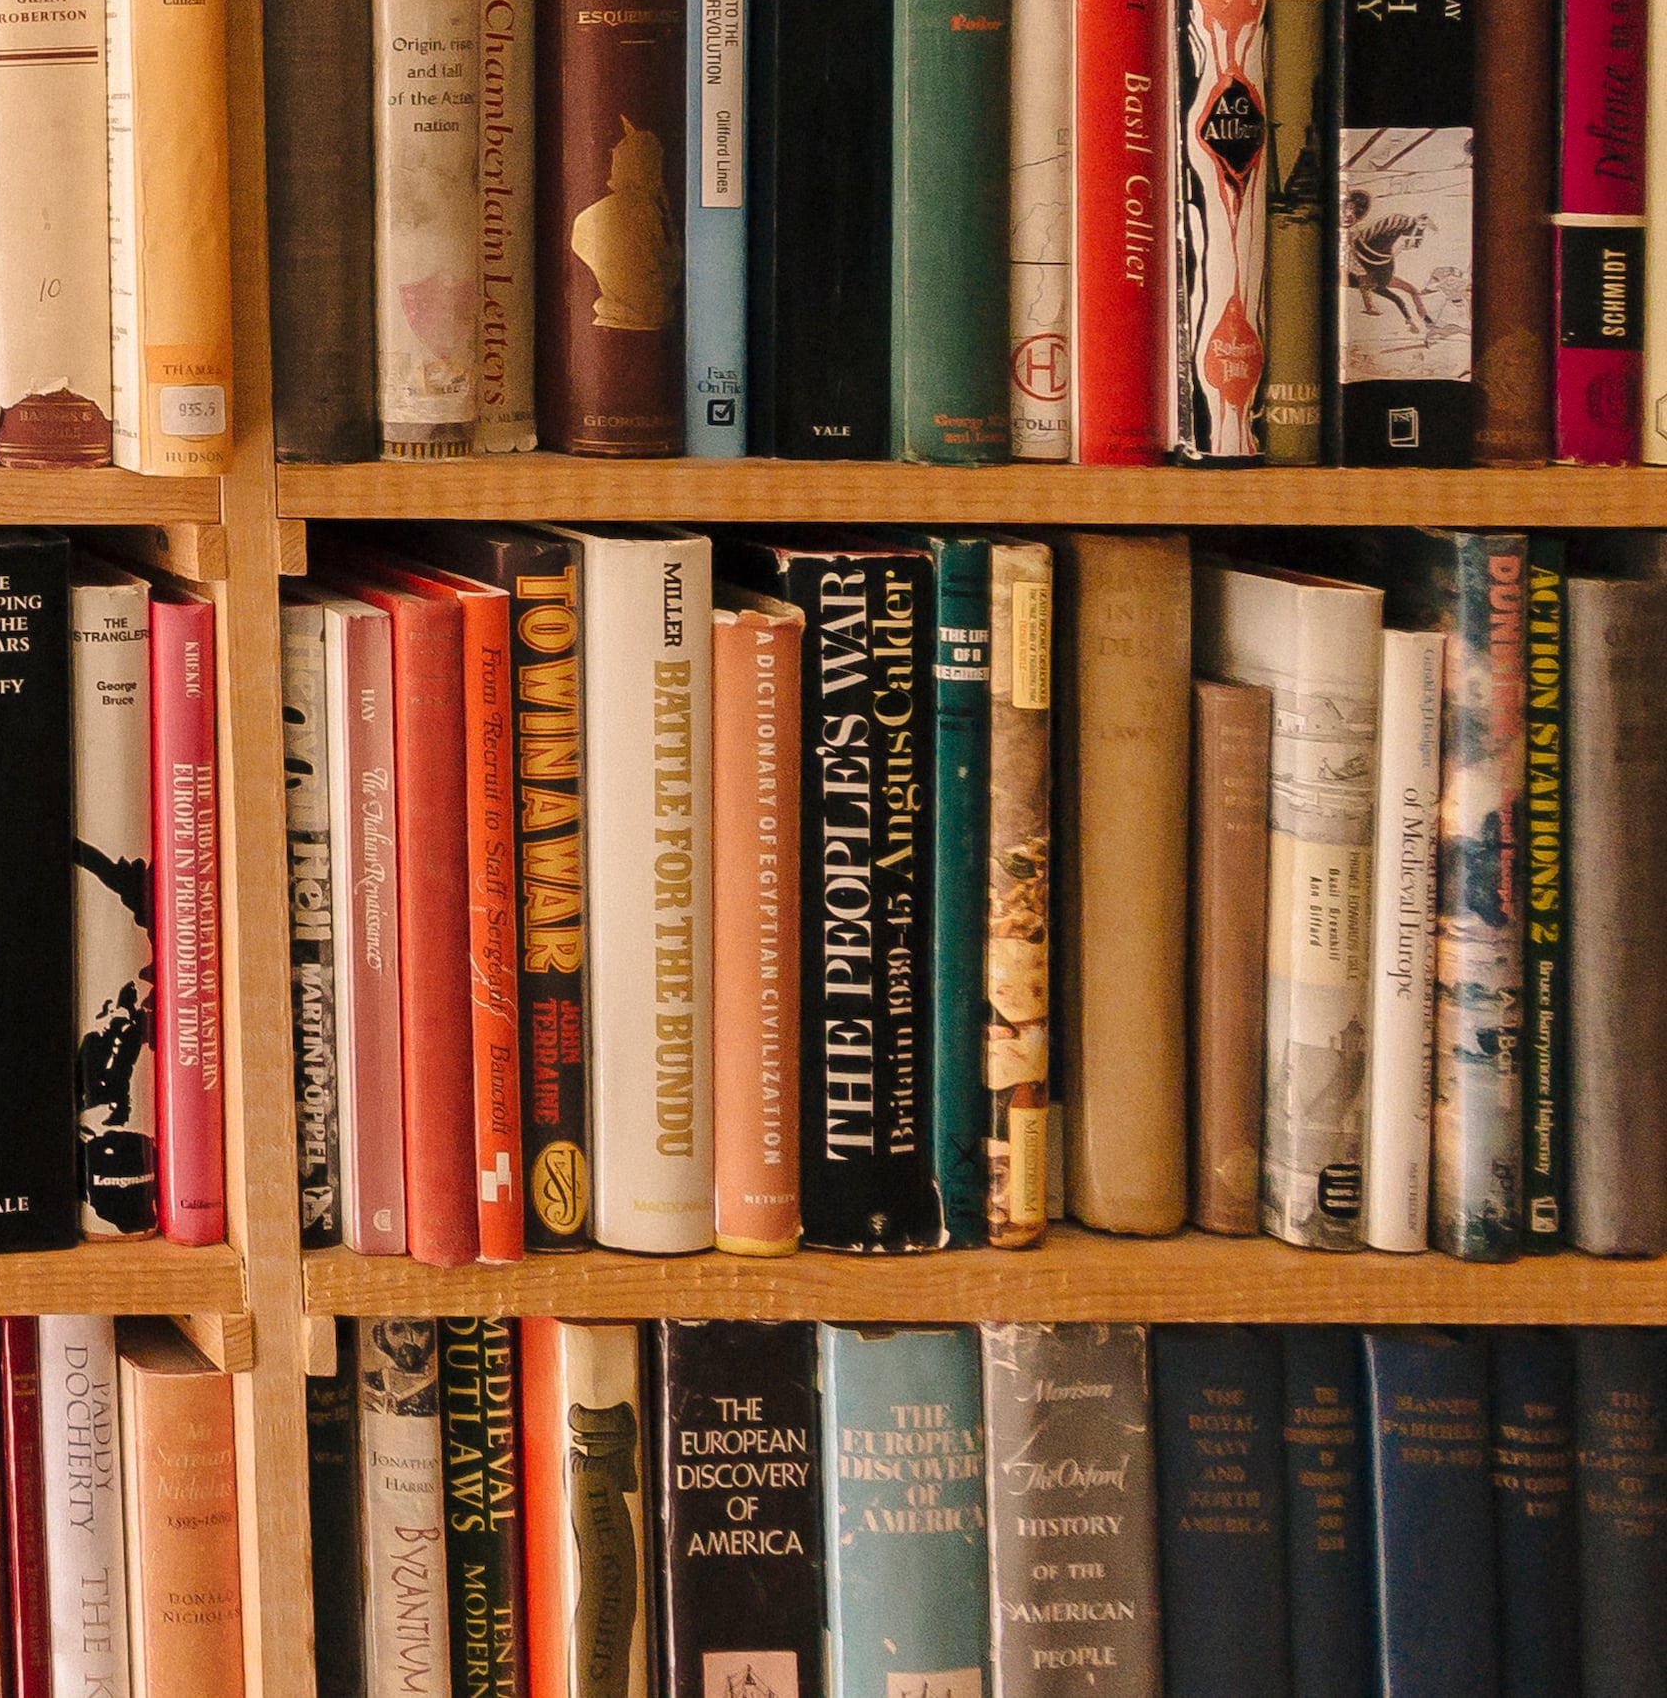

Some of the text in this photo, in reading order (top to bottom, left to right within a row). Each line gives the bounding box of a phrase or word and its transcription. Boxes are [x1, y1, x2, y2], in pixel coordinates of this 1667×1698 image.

[1124, 73, 1152, 287] Basil Collier
[1601, 248, 1628, 337] SCHMIDT
[812, 424, 851, 436] YALE
[664, 562, 681, 648] MILLER
[872, 568, 923, 880] Angus Calder
[1529, 565, 1562, 944] ACTION STATIONS 2
[816, 568, 874, 1161] THE PEOPLE'S WAR
[715, 1399, 763, 1422] THE
[681, 1431, 806, 1455] EUROPEAN
[677, 1463, 808, 1490] DISCOVERY
[728, 1498, 758, 1521] OF
[1017, 1516, 1124, 1537] HISTORY
[687, 1531, 804, 1556] AMERICA
[1033, 1648, 1117, 1669] PEOPLE
